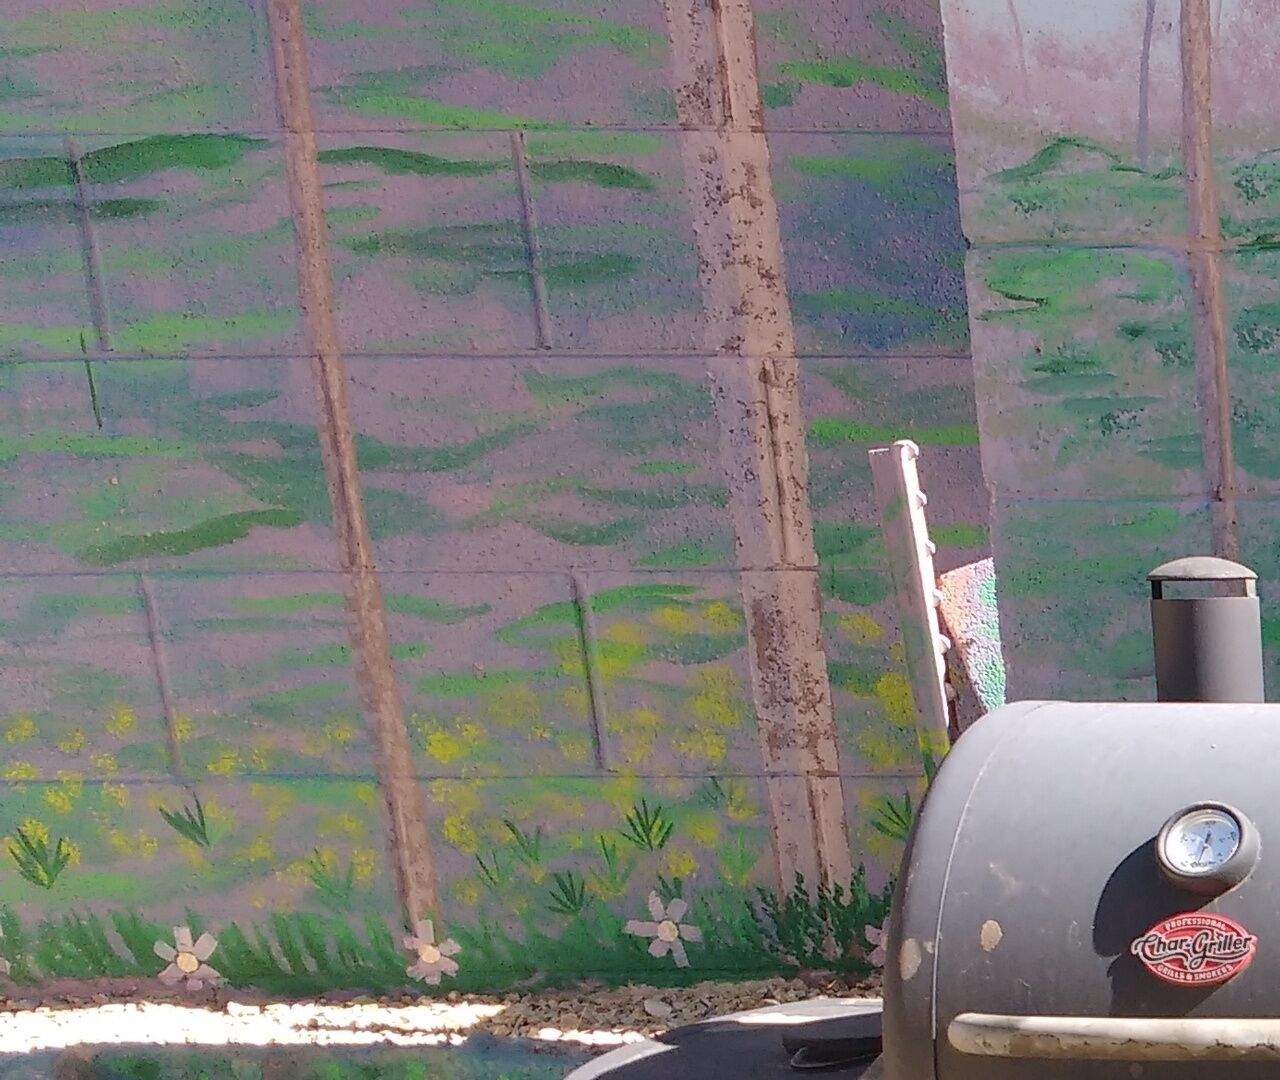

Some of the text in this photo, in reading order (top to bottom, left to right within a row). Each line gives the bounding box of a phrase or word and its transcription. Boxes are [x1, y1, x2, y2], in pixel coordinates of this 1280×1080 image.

[1165, 917, 1227, 931] PROFESSIONAL
[1132, 929, 1253, 971] Char-Griller
[1156, 963, 1185, 979] GRILLS
[1194, 964, 1234, 981] SMOKERS
